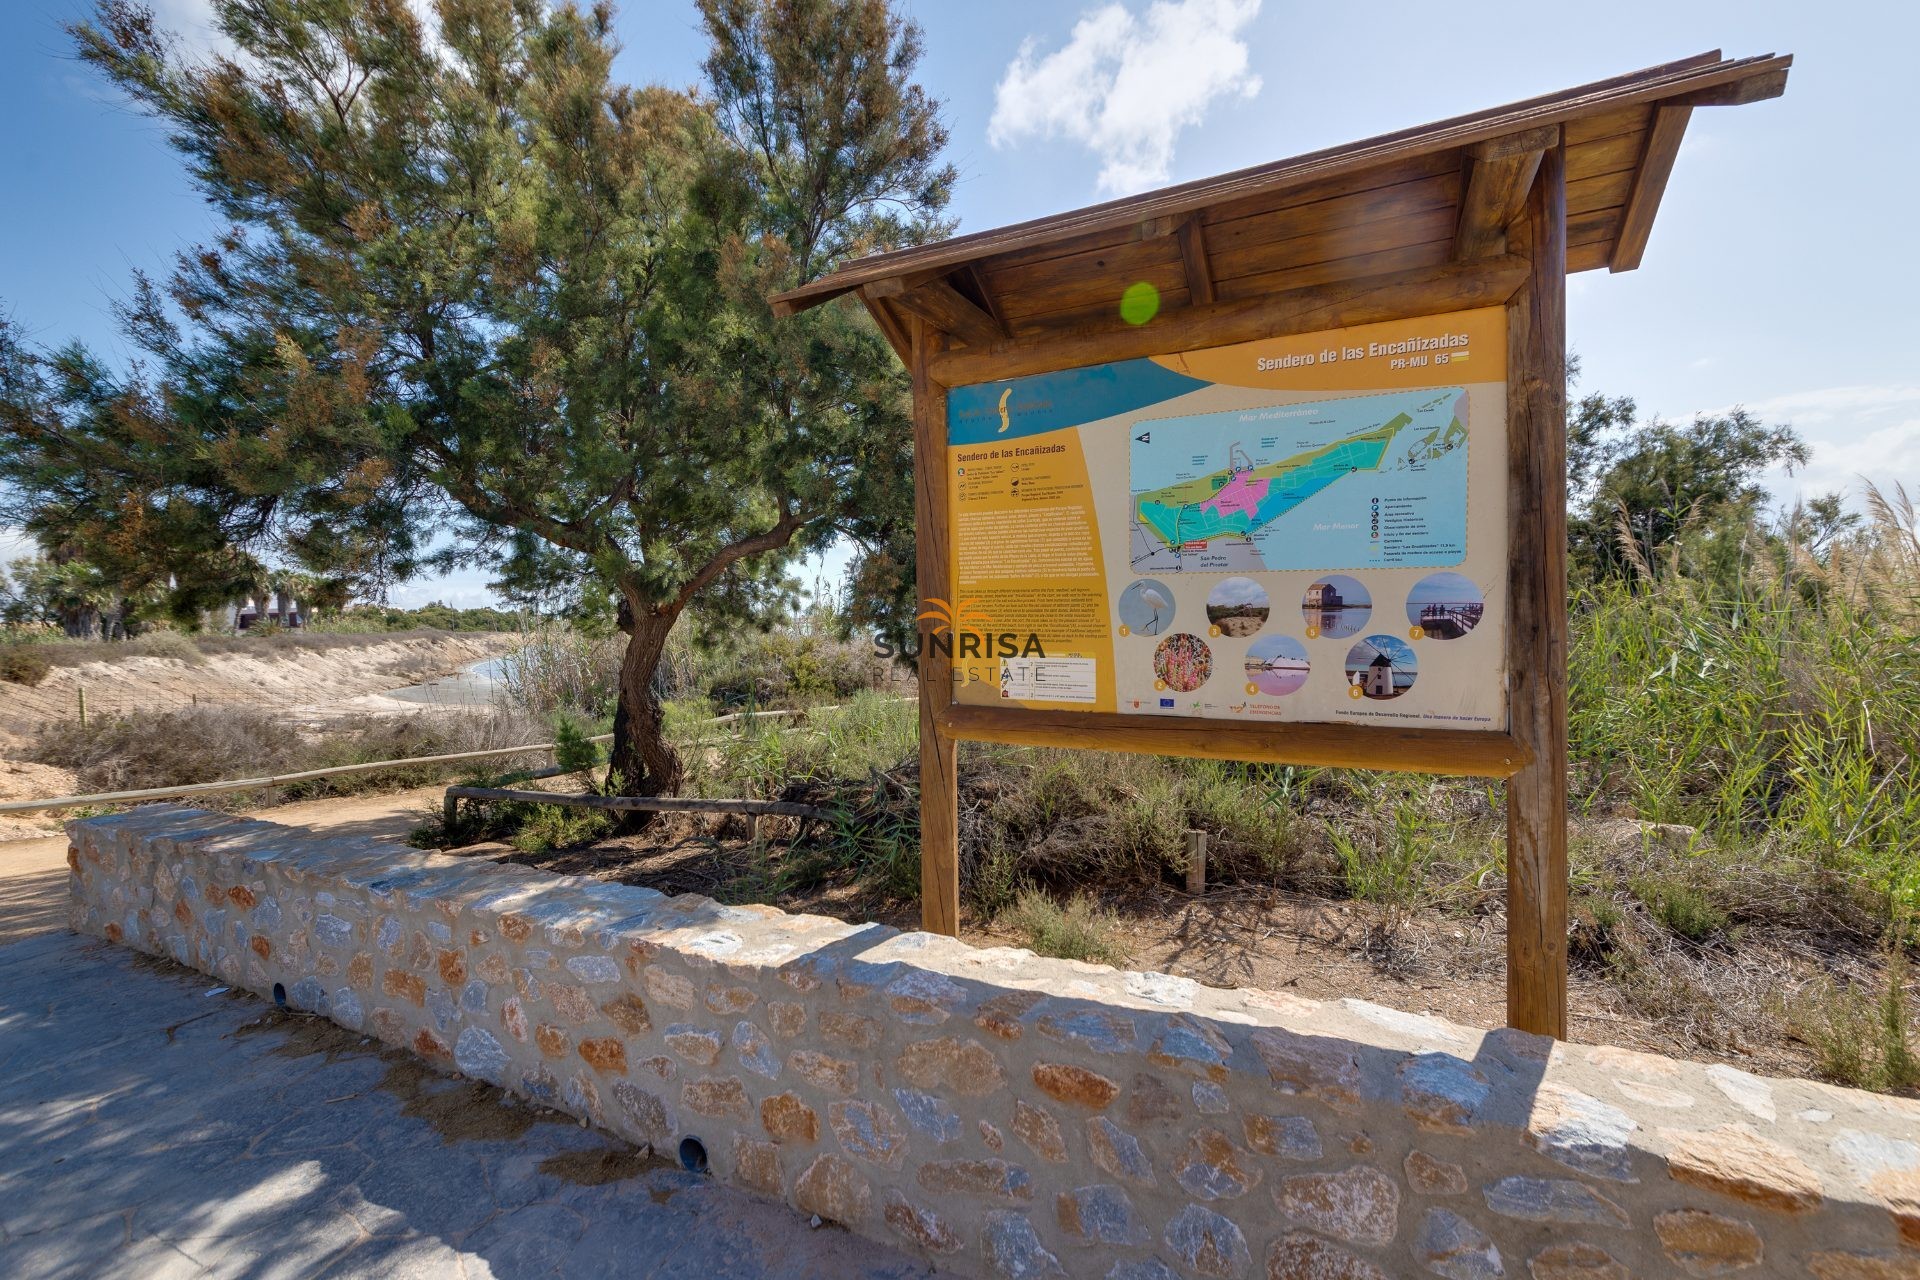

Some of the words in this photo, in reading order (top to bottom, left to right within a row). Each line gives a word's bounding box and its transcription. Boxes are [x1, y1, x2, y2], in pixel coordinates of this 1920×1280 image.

[1257, 353, 1315, 371] Sendero
[1319, 350, 1337, 363] de
[1342, 346, 1365, 361] las
[1369, 332, 1470, 357] Encañizadas
[1390, 356, 1428, 370] PR-MU
[1435, 353, 1449, 364] 65
[1239, 414, 1256, 422] Mar
[958, 452, 988, 462] Sendero
[990, 450, 1000, 459] de
[1002, 449, 1013, 458] las
[1016, 444, 1066, 457] Encañizadas
[1313, 523, 1330, 531] Mar
